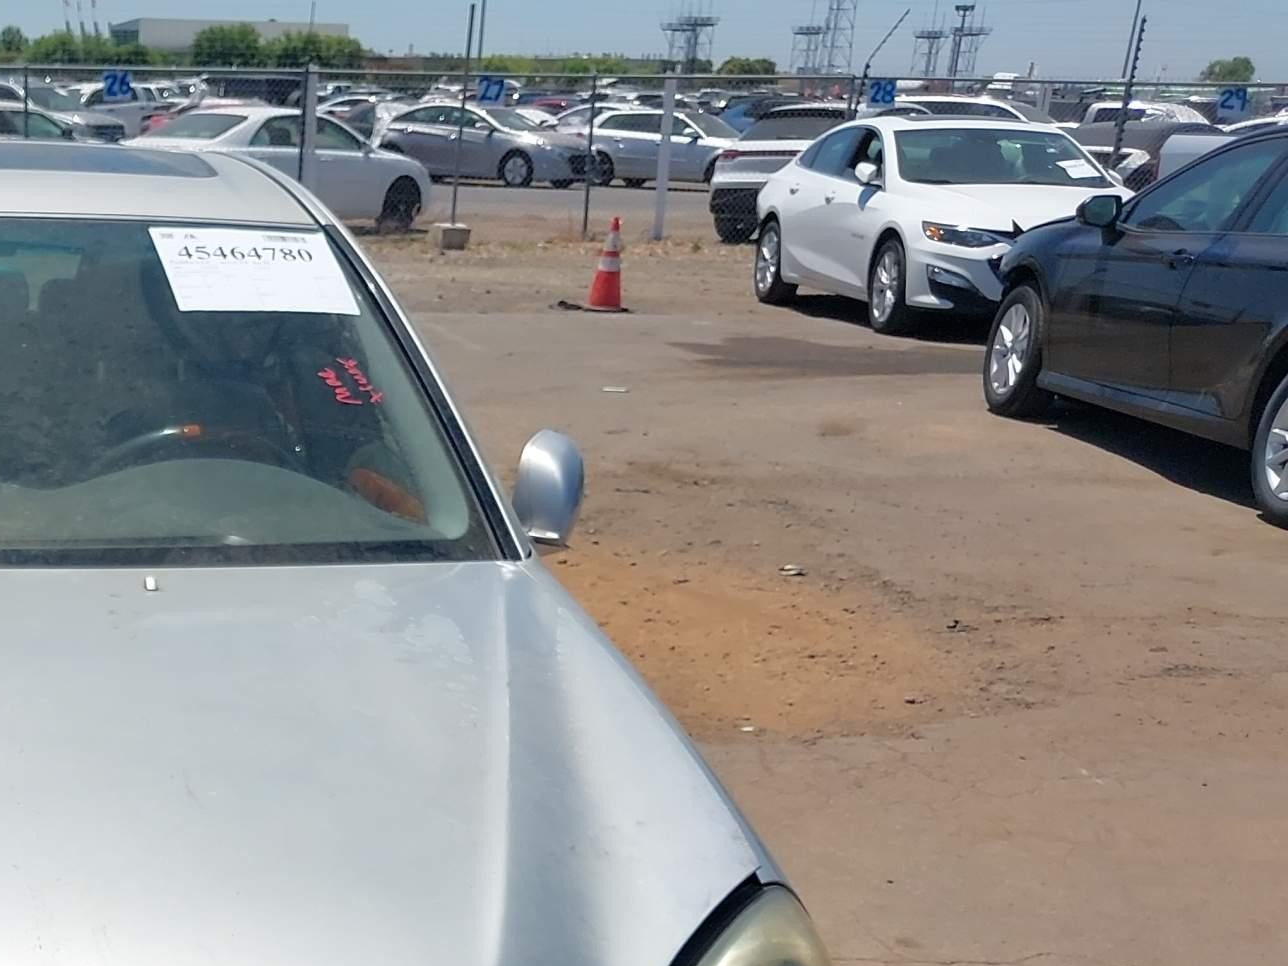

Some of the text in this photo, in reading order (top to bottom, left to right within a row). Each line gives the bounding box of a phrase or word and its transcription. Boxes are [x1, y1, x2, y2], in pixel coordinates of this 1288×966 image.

[104, 71, 130, 97] 26
[479, 76, 504, 102] 27
[869, 80, 896, 104] 28
[1219, 87, 1248, 112] 29
[177, 245, 313, 263] 45464780
